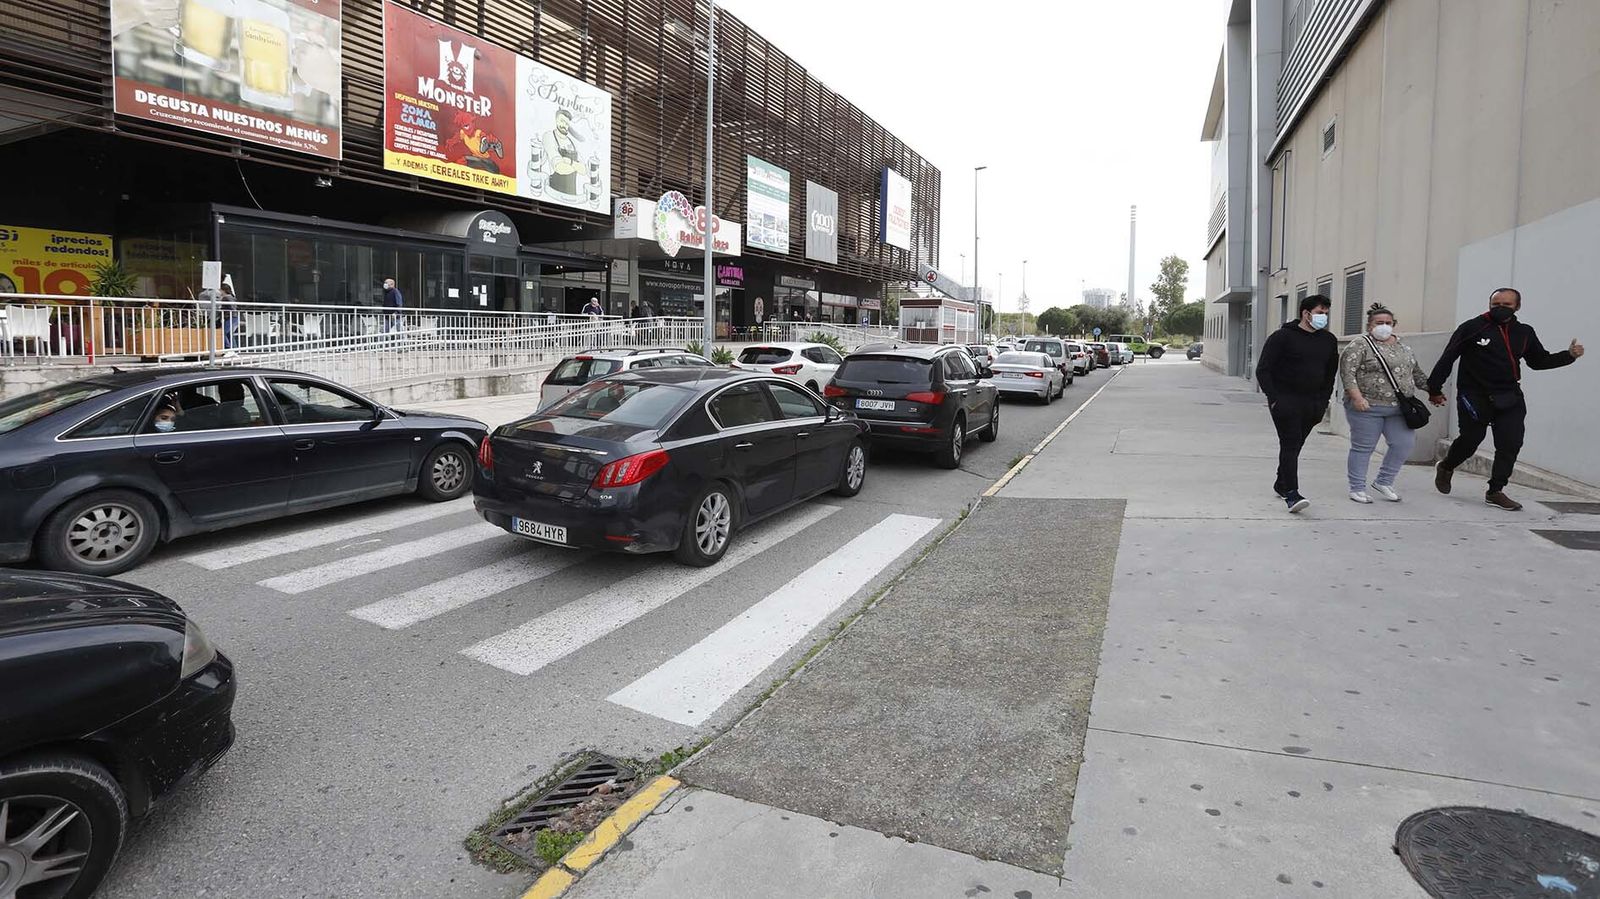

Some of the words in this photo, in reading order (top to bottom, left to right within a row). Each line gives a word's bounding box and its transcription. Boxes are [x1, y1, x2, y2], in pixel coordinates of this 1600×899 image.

[417, 75, 492, 117] MONSTER
[134, 89, 209, 117] DEGUSTA
[212, 106, 283, 134] NUESTROS
[286, 124, 329, 145] MENÚS
[149, 108, 193, 124] Cruzcampo
[401, 103, 432, 120] ZONA
[400, 113, 437, 131] GAMER
[472, 173, 489, 185] TAKE
[52, 233, 103, 247] ¡precios
[44, 244, 109, 258] redondos!
[12, 258, 41, 266] miles
[664, 260, 691, 271] NOVA
[717, 265, 744, 281] CANTINA
[13, 266, 92, 305] 10
[860, 400, 878, 408] 8007
[880, 401, 894, 409] JVH
[519, 520, 542, 536] 9684
[544, 525, 564, 541] HYR
